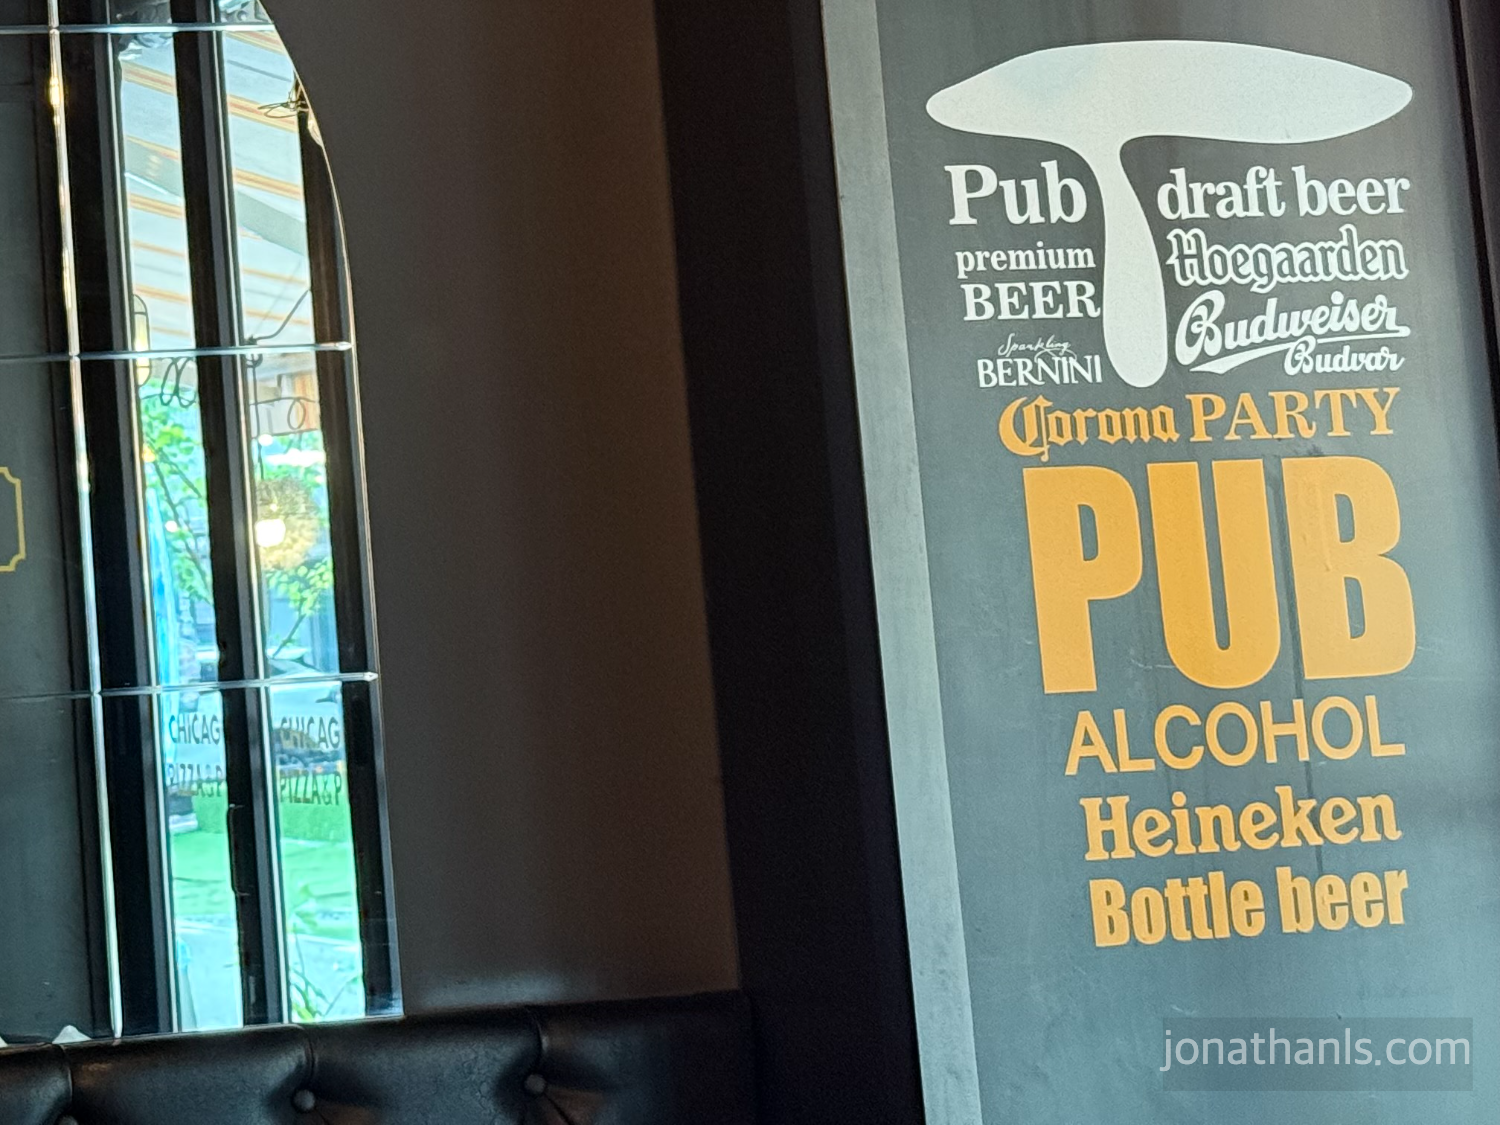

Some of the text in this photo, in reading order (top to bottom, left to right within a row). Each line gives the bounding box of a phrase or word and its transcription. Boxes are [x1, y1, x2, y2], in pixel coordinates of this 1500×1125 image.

[943, 160, 1089, 226] Pub
[1156, 164, 1411, 221] draft beer
[955, 240, 1096, 279] premium
[1165, 223, 1409, 295] Hoegaarden
[960, 279, 1102, 322] BEER
[1175, 290, 1411, 370] Budweiser
[976, 355, 1103, 388] BERNINI
[1283, 336, 1406, 376] Budvar
[998, 386, 1402, 463] Corona PARTY
[1022, 454, 1417, 695] PUB
[1064, 695, 1406, 777] ALCOHOL
[1079, 784, 1402, 863] Heineken
[1088, 865, 1410, 948] Bottle beer
